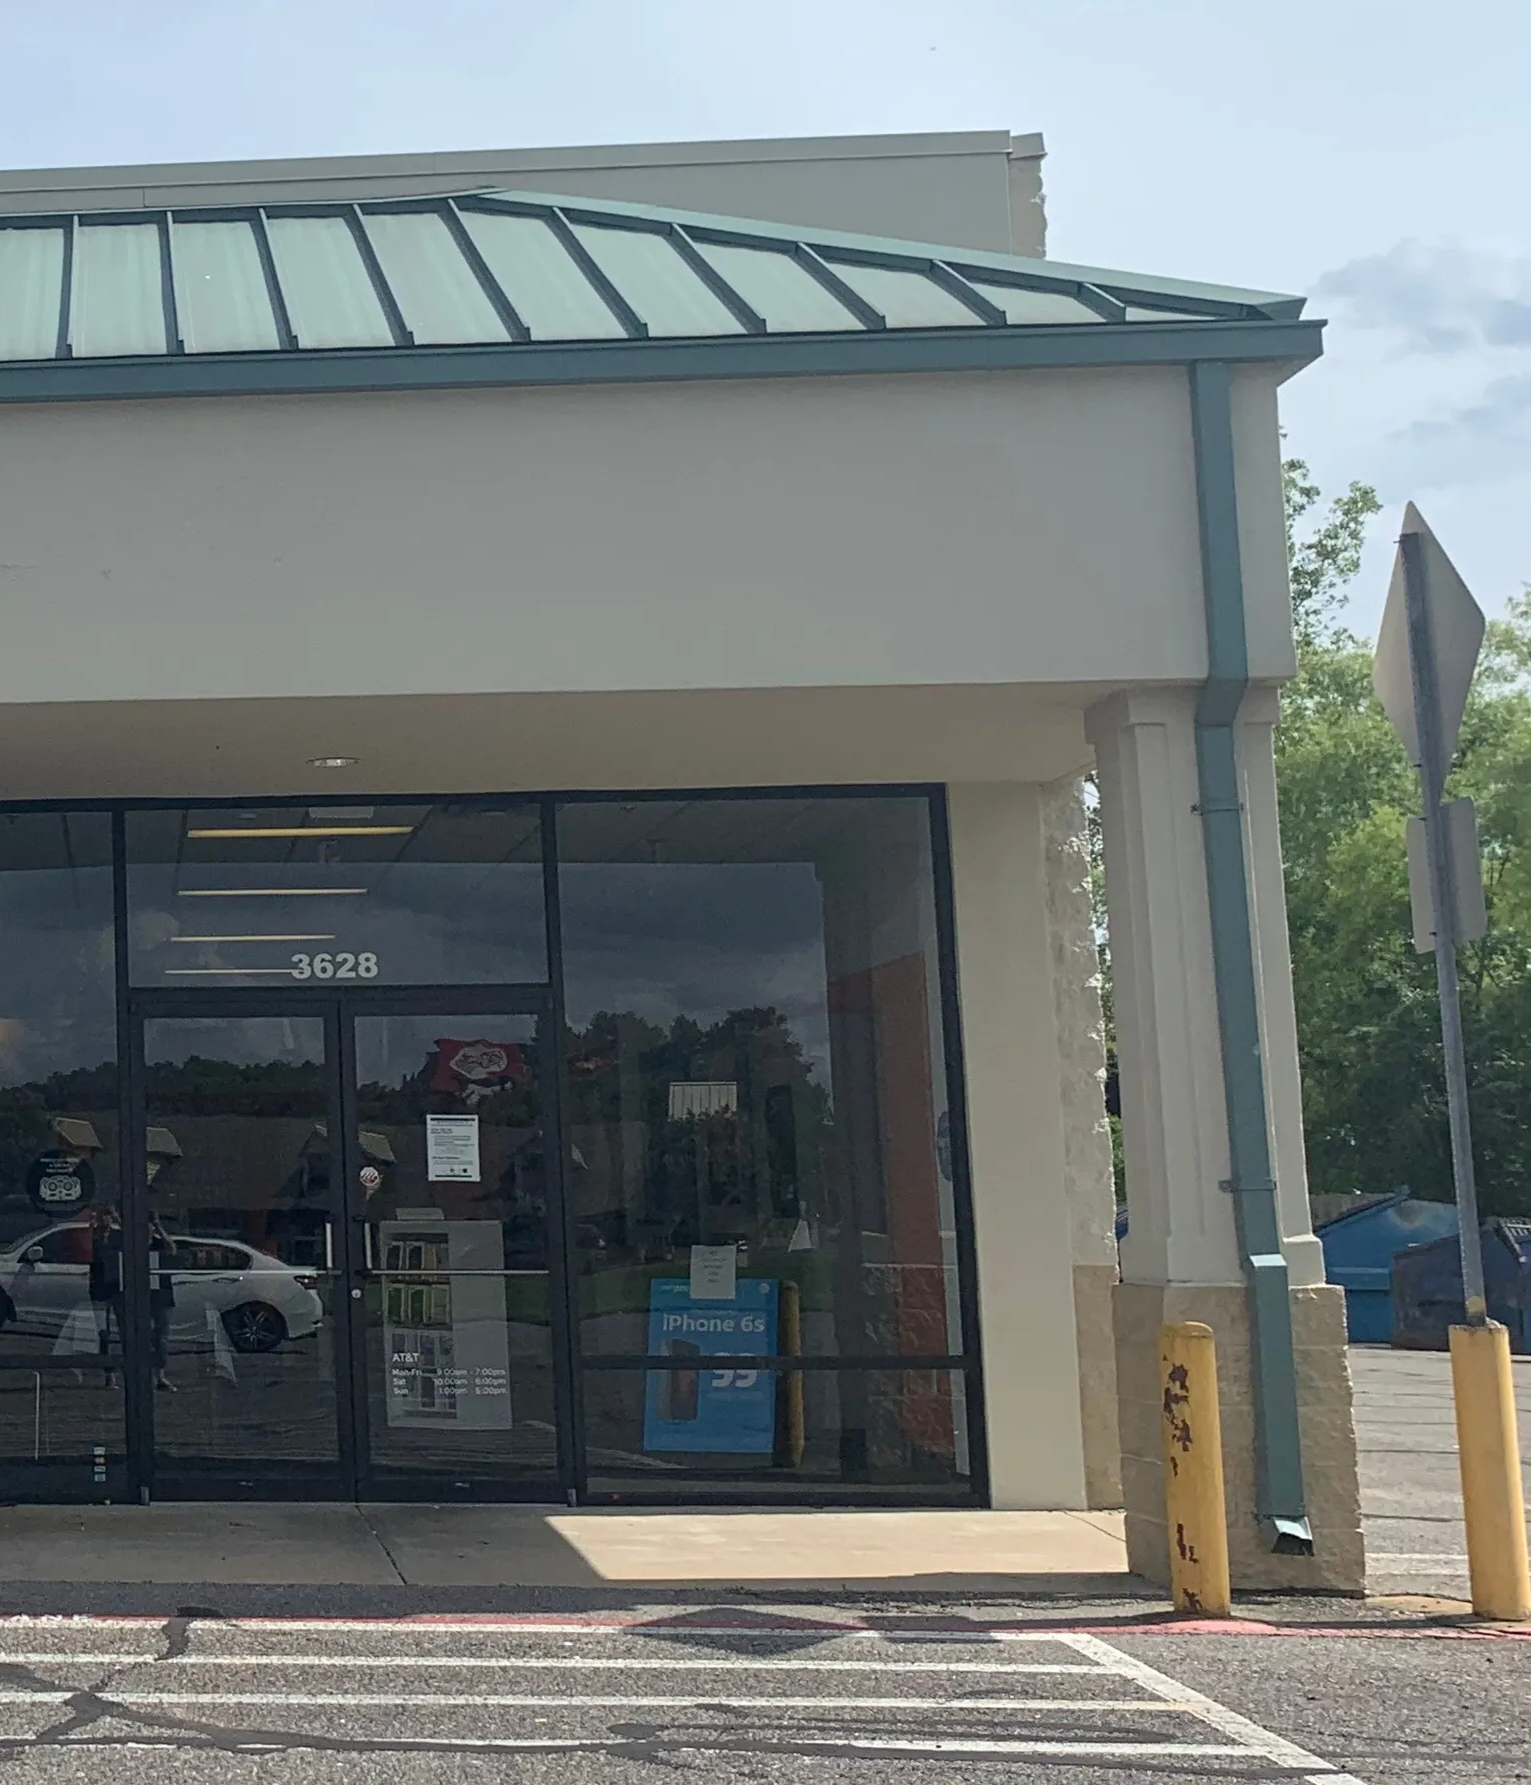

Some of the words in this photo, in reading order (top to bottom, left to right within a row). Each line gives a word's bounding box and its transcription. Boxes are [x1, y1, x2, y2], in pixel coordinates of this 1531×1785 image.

[291, 952, 378, 979] 3628
[662, 1313, 735, 1333] iPhone
[741, 1314, 765, 1332] 6s
[392, 1352, 420, 1362] AT&T
